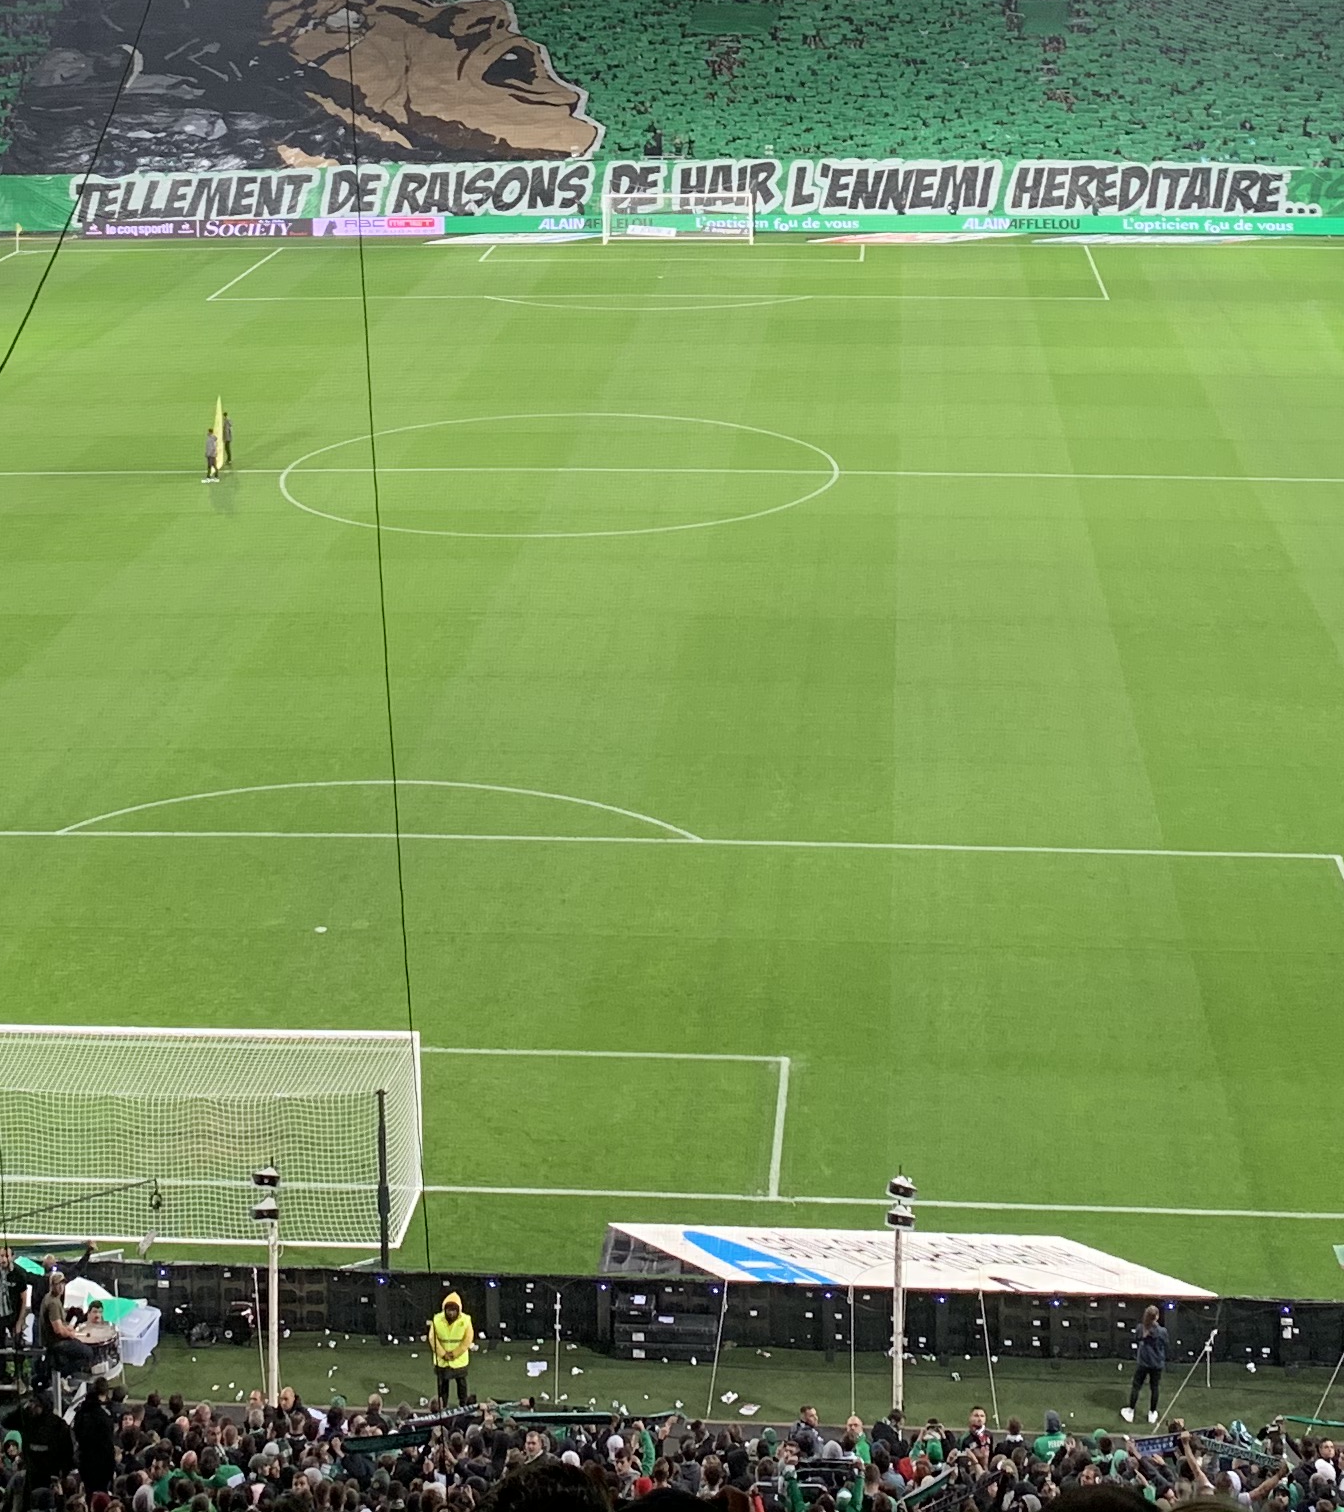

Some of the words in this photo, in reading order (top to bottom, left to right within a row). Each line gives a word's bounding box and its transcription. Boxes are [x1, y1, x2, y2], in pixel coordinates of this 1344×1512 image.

[75, 173, 314, 221] TELLEMENT
[327, 170, 382, 215] DE
[392, 164, 590, 216] RAISONS
[610, 165, 661, 211] DE
[679, 162, 777, 208] HAIR
[791, 163, 995, 210] L'ENNEMI
[538, 218, 585, 230] ALAIN
[774, 218, 798, 232] fou
[803, 218, 820, 229] de
[824, 220, 860, 229] vous
[963, 218, 1009, 230] ALAIN
[1009, 218, 1081, 230] AFFLELOU
[1122, 219, 1199, 233] L'opticien
[1204, 219, 1230, 234] fou
[1236, 219, 1253, 231] de
[1257, 221, 1294, 231] vous
